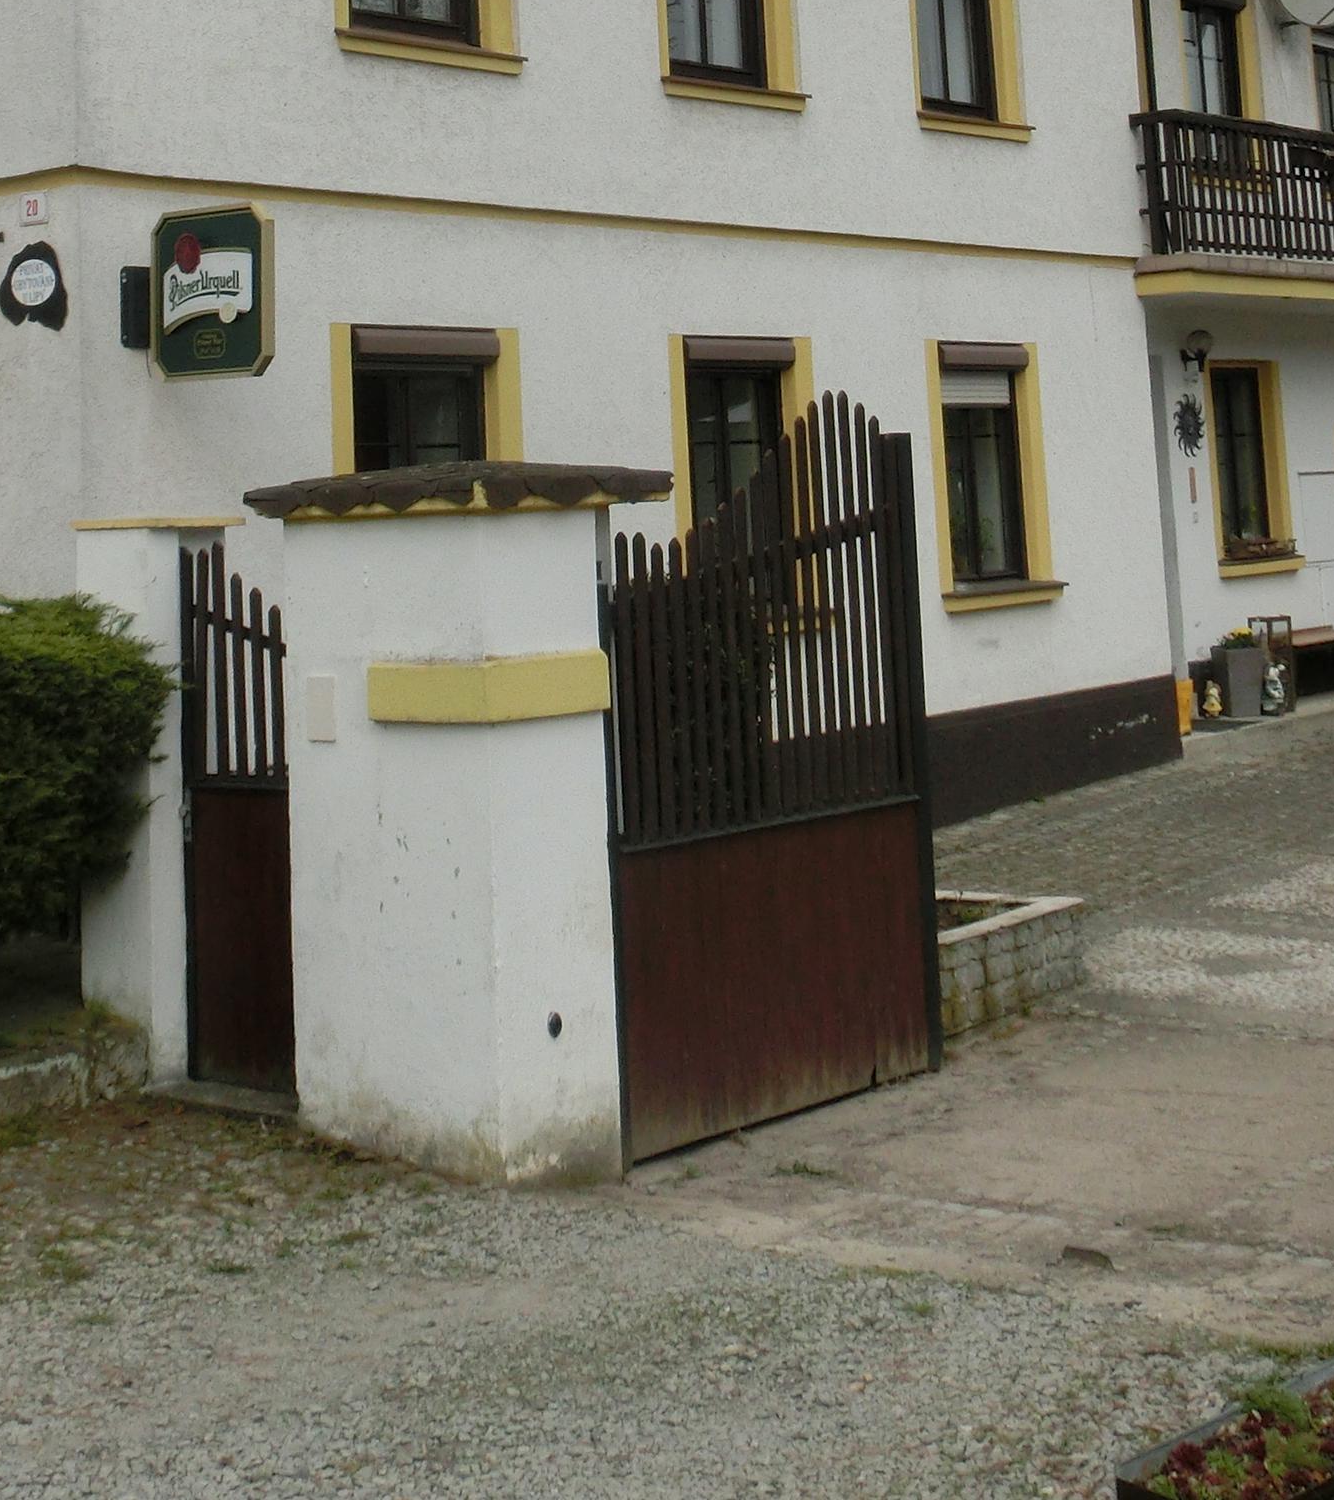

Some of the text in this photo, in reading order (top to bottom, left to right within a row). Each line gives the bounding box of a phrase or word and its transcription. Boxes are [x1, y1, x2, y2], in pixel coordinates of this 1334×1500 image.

[26, 199, 38, 216] 20
[169, 269, 241, 312] Pilsner Urquell
